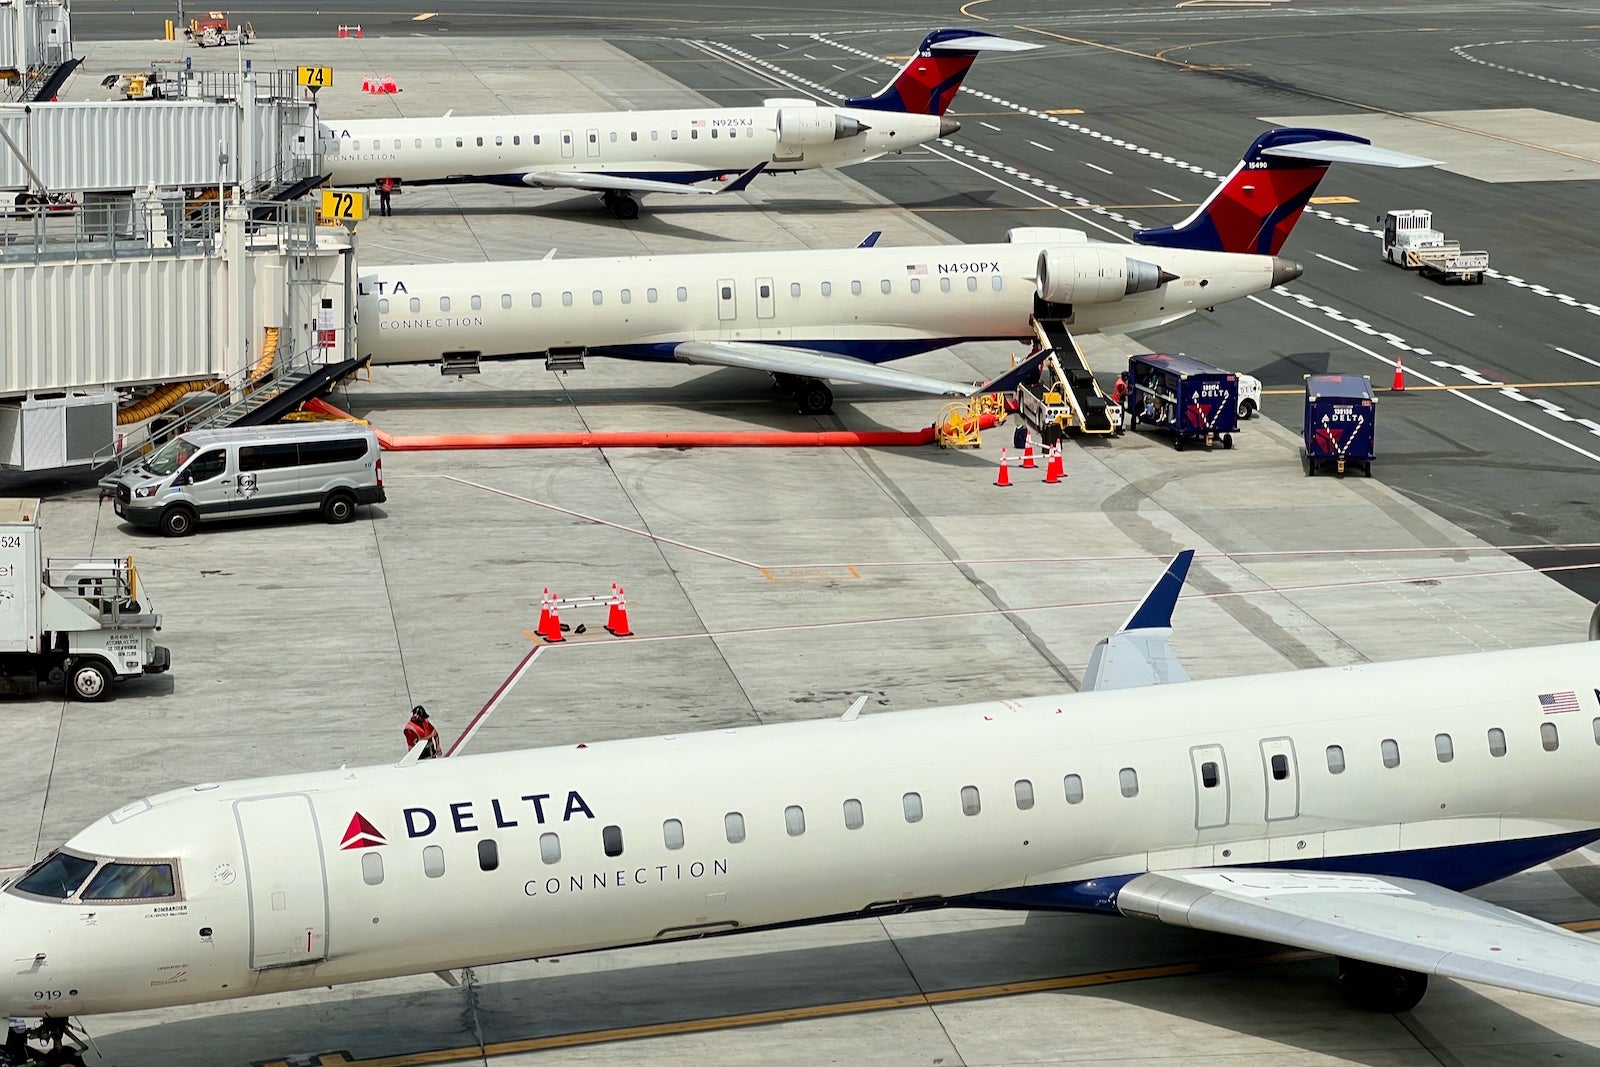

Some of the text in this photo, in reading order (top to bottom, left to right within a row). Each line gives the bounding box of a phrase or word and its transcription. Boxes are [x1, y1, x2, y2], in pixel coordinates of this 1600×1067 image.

[306, 68, 323, 85] 74
[712, 118, 753, 127] N925XJ
[326, 153, 396, 162] CONNECTION
[332, 193, 353, 218] 72
[938, 262, 1000, 274] N490PX
[380, 317, 483, 330] CONNECTION
[1201, 390, 1229, 398] DELTA
[0, 536, 20, 548] 524
[403, 790, 595, 838] DELTA
[524, 859, 728, 897] CONNECTION
[34, 990, 61, 1000] 919
